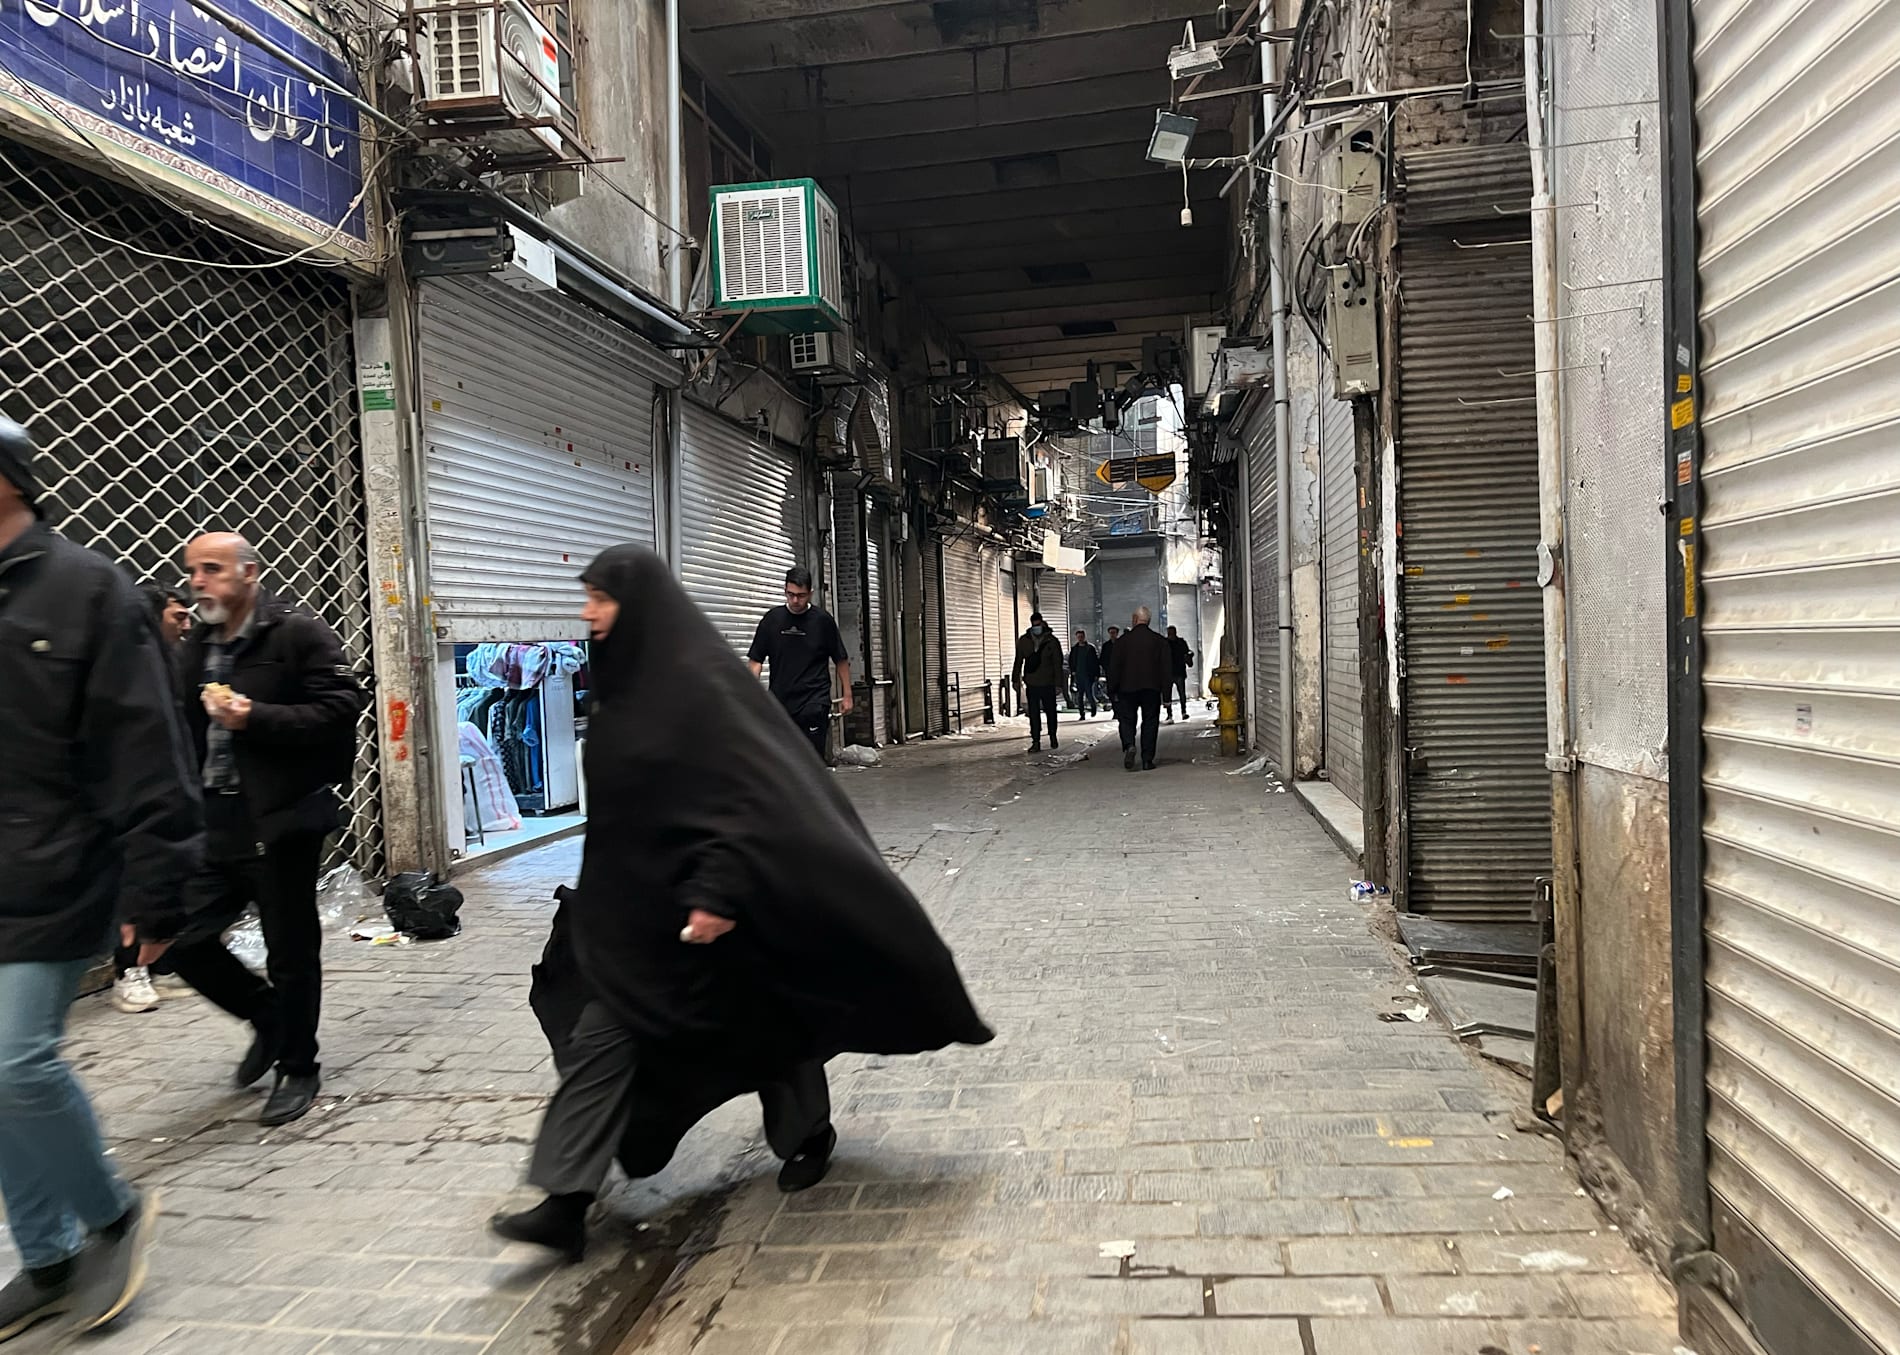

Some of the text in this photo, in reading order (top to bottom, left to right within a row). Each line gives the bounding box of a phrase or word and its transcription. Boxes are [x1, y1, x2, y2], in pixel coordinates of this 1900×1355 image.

[147, 3, 241, 93] اقتصاد
[100, 75, 196, 146] شعبه بازار
[246, 76, 345, 159] سازمان
